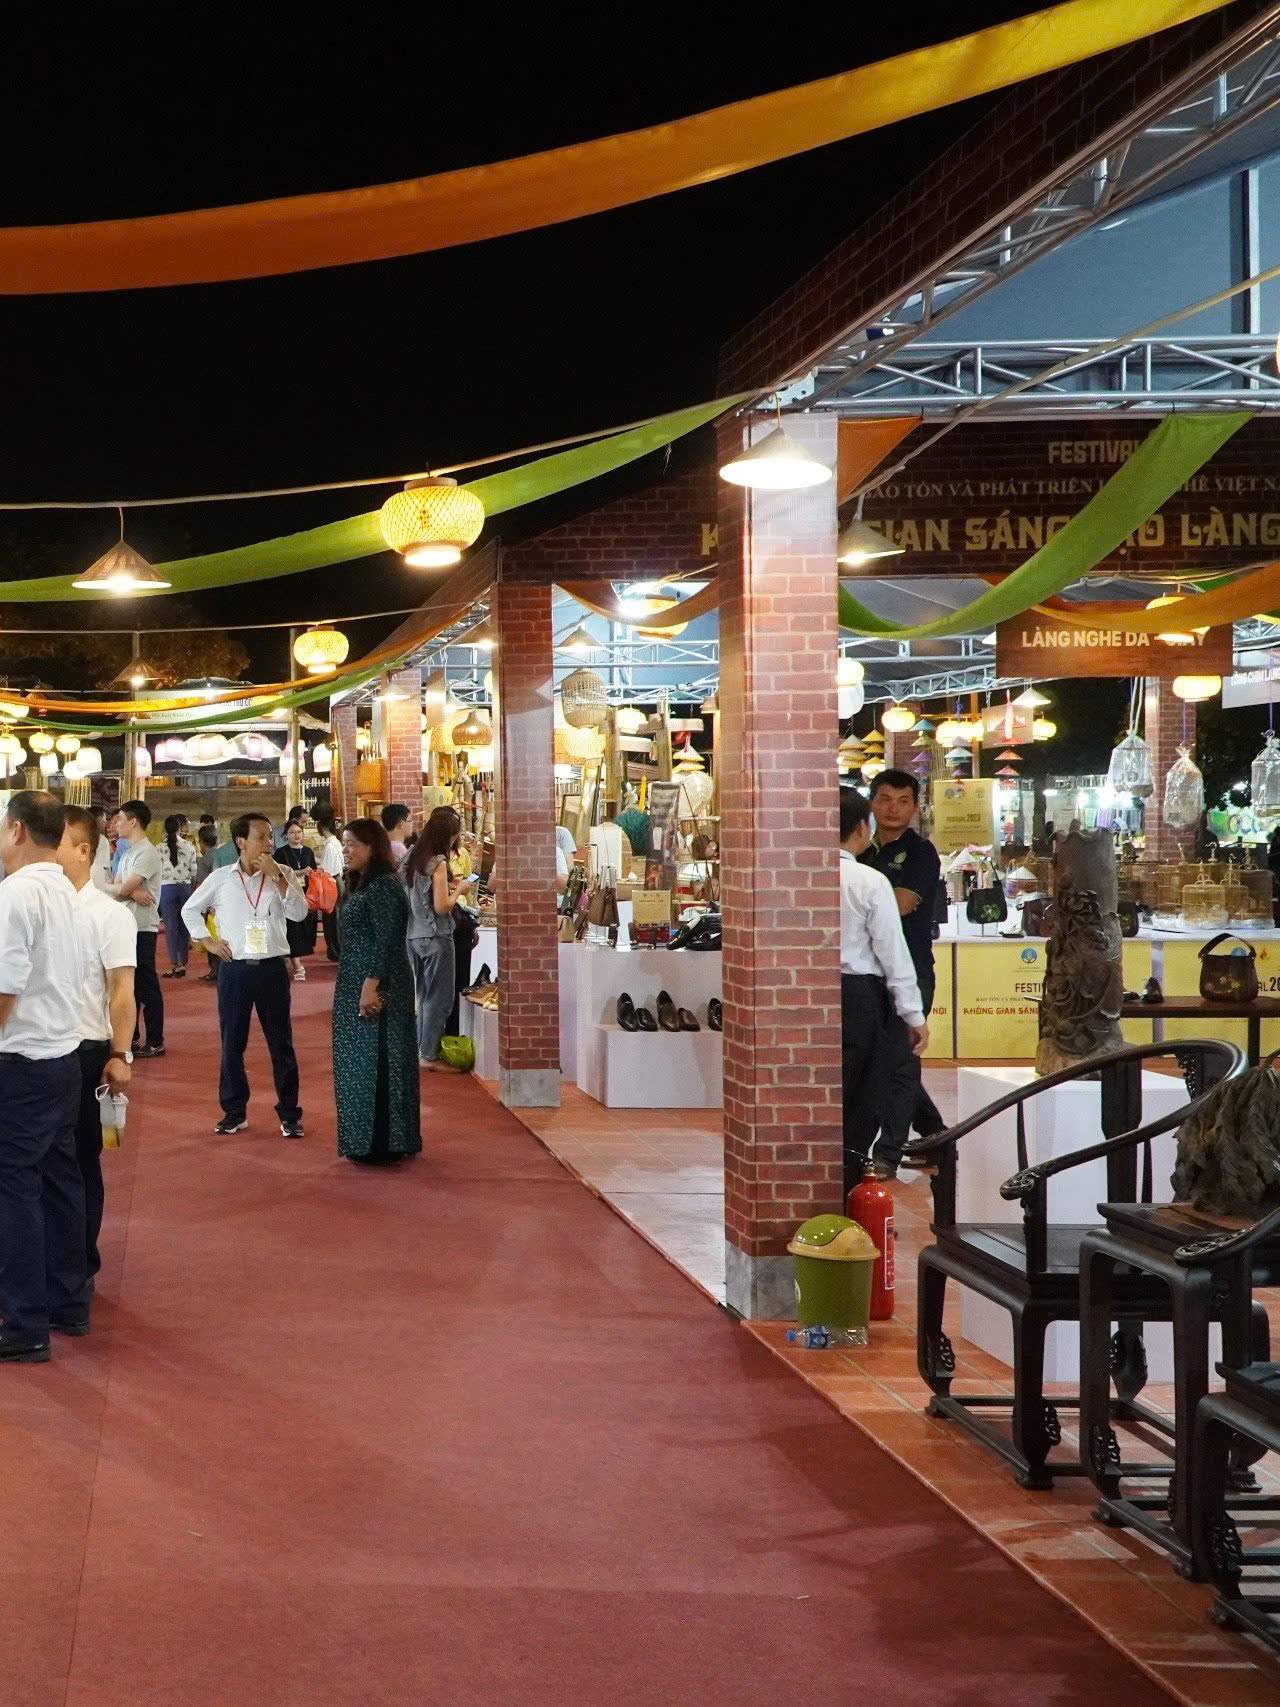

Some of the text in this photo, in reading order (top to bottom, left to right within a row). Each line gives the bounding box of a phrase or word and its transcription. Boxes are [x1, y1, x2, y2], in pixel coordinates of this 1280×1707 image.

[1048, 439, 1142, 464] FESTIVA
[1022, 626, 1070, 648] LÀNG
[1125, 631, 1150, 647] DA
[1015, 982, 1041, 993] FESTI
